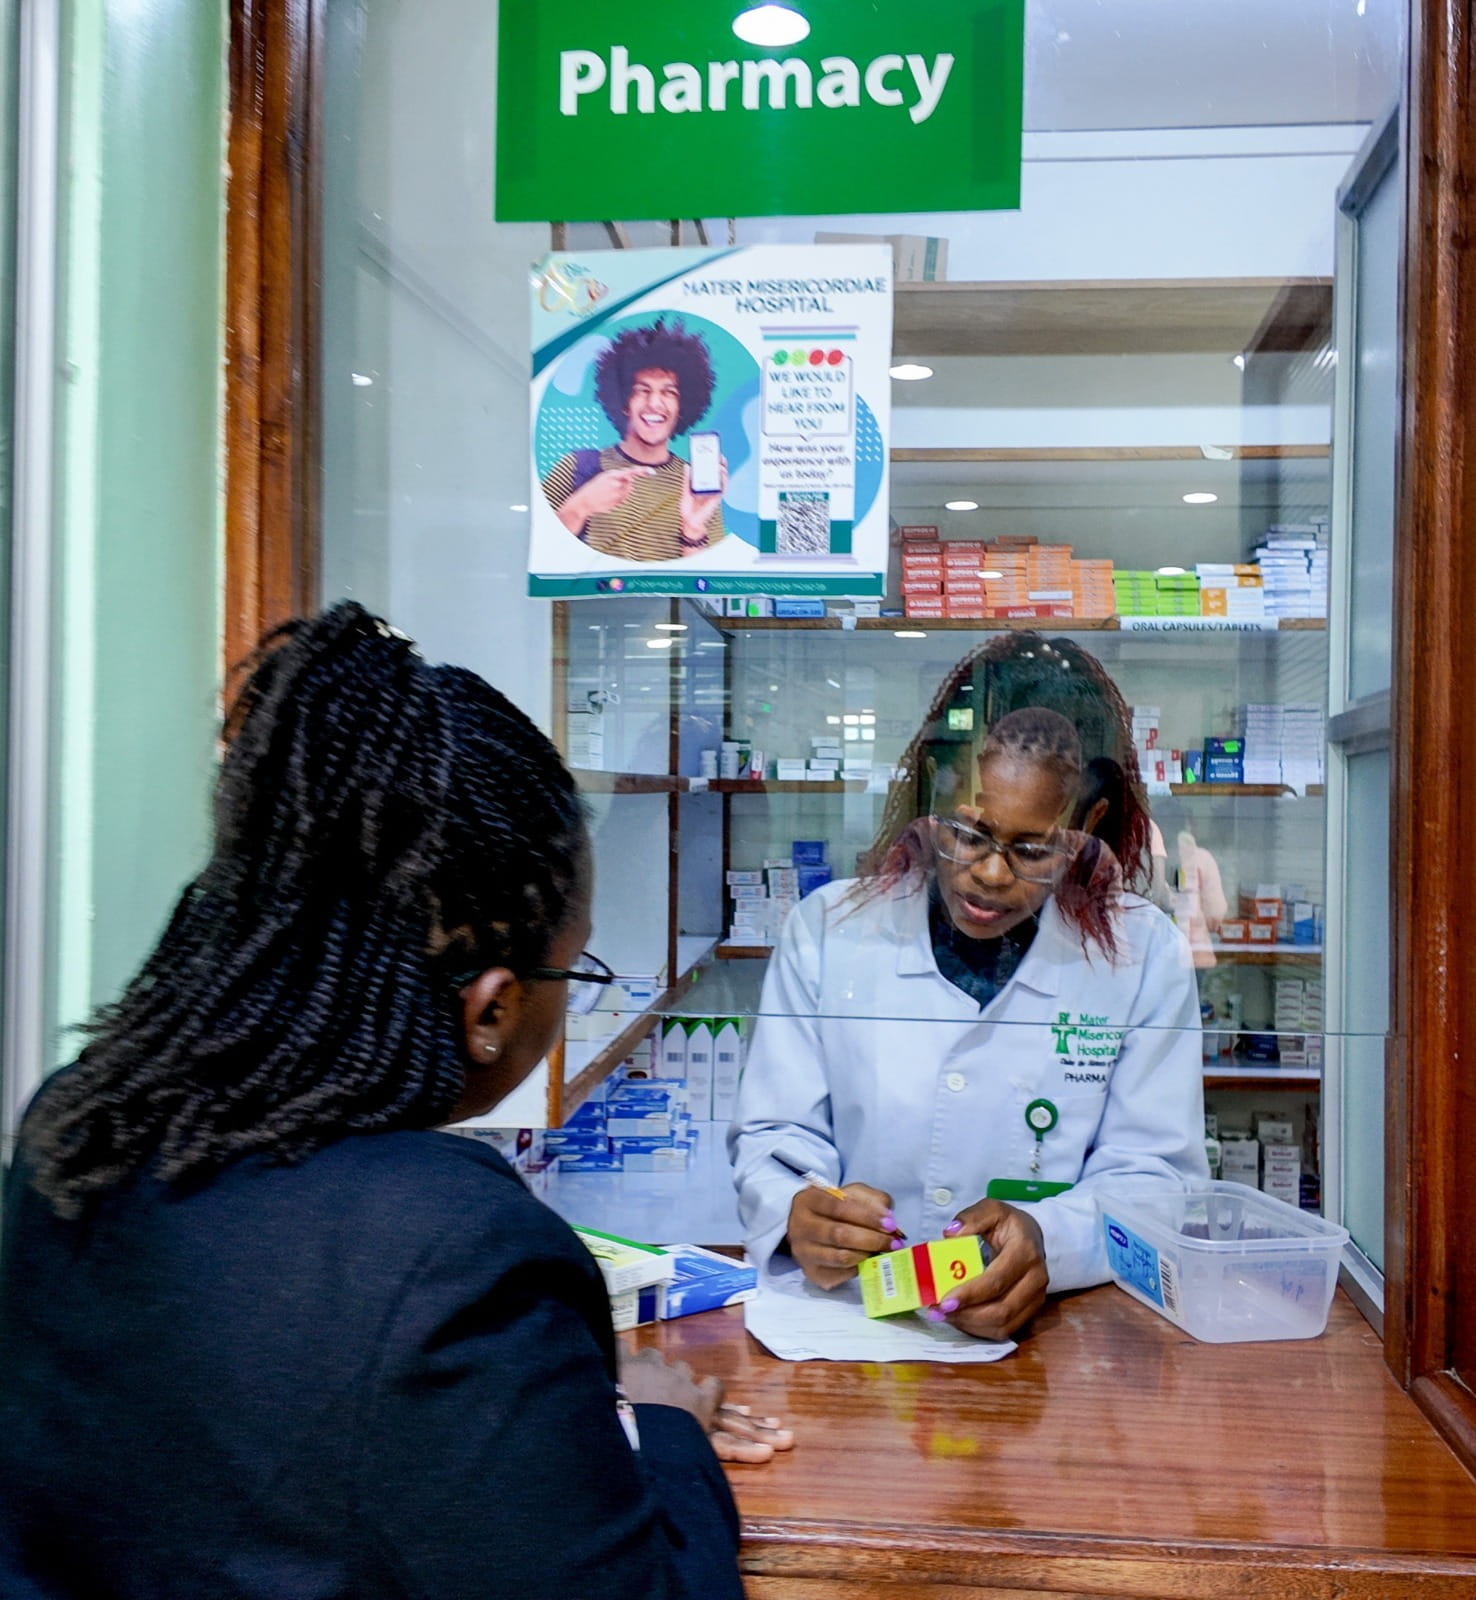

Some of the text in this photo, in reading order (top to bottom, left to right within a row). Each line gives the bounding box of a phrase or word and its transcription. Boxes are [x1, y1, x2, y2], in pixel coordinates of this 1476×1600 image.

[560, 45, 955, 124] Pharmacy
[682, 277, 887, 295] MATER MISERICORDIAE
[735, 296, 834, 313] HOSPITAL
[1132, 622, 1262, 633] ORAL CAPSULES/TABLETS
[1079, 1012, 1109, 1026] Mater
[1077, 1044, 1118, 1058] Hospital
